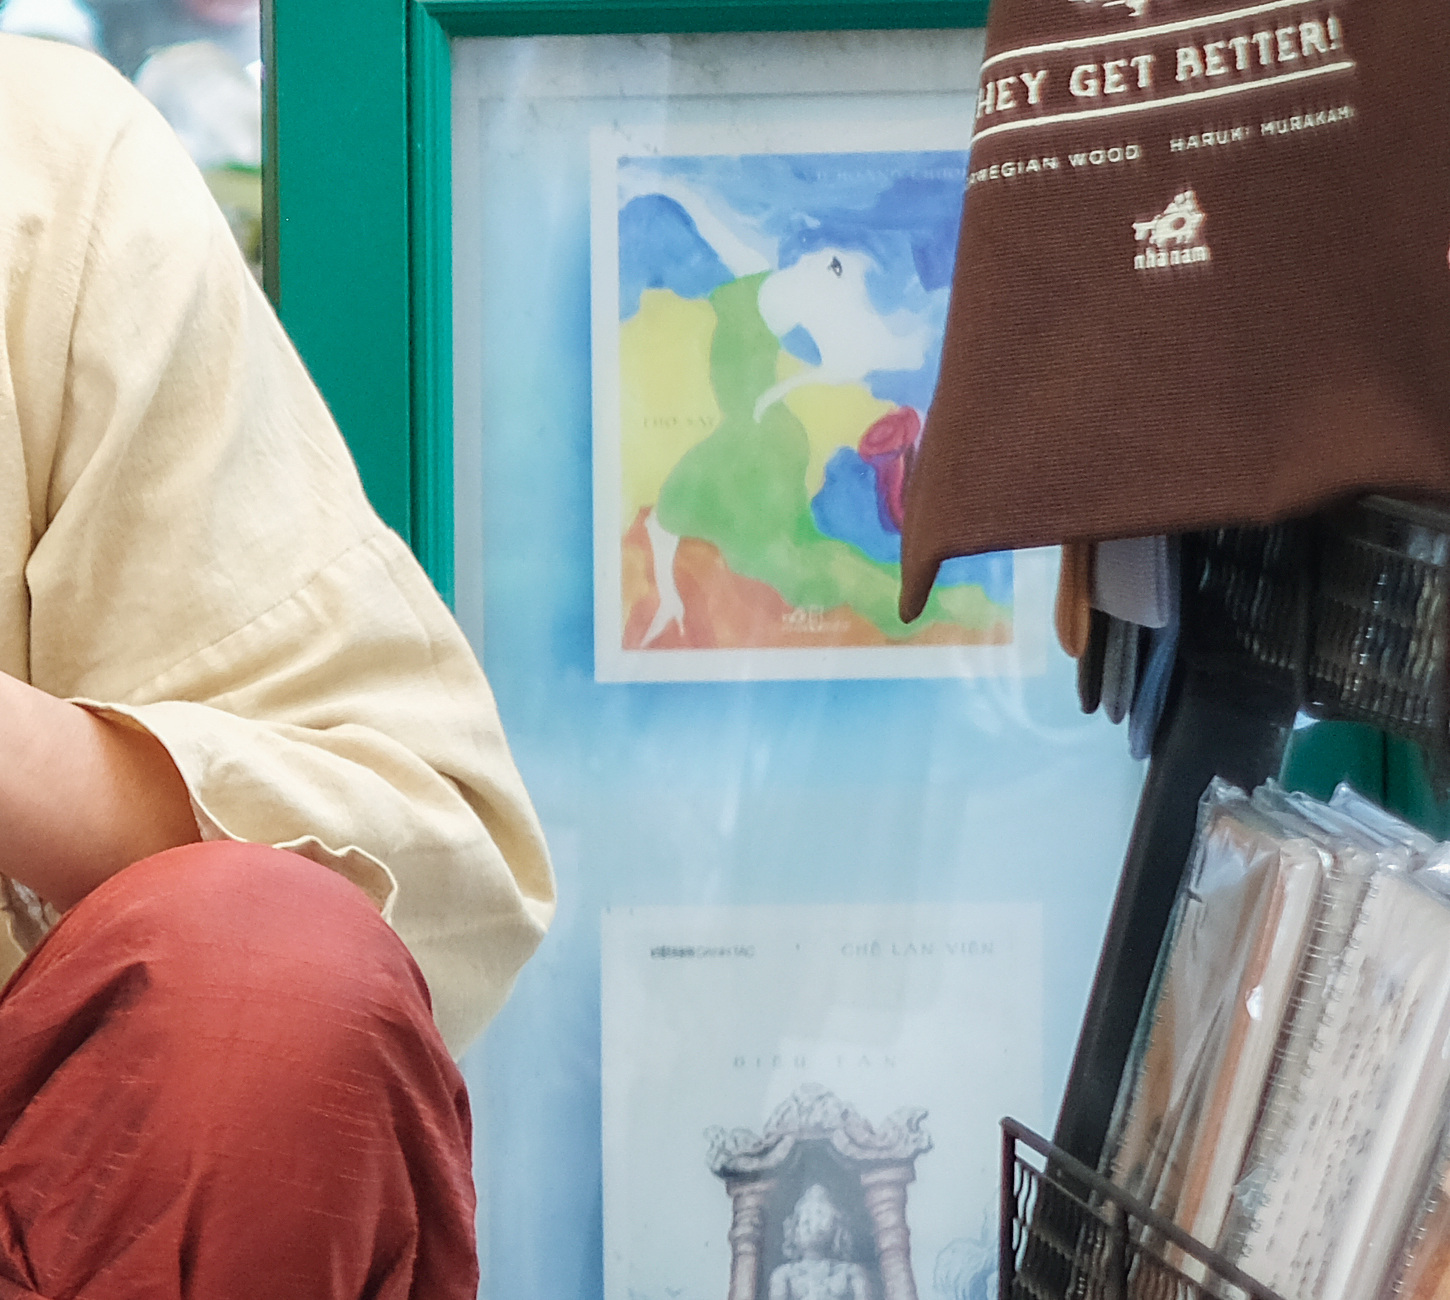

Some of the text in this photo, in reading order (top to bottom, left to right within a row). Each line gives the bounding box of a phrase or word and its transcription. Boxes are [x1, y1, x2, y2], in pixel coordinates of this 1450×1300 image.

[975, 16, 1344, 118] HEY GET BETTER!
[1068, 144, 1141, 168] WOOD
